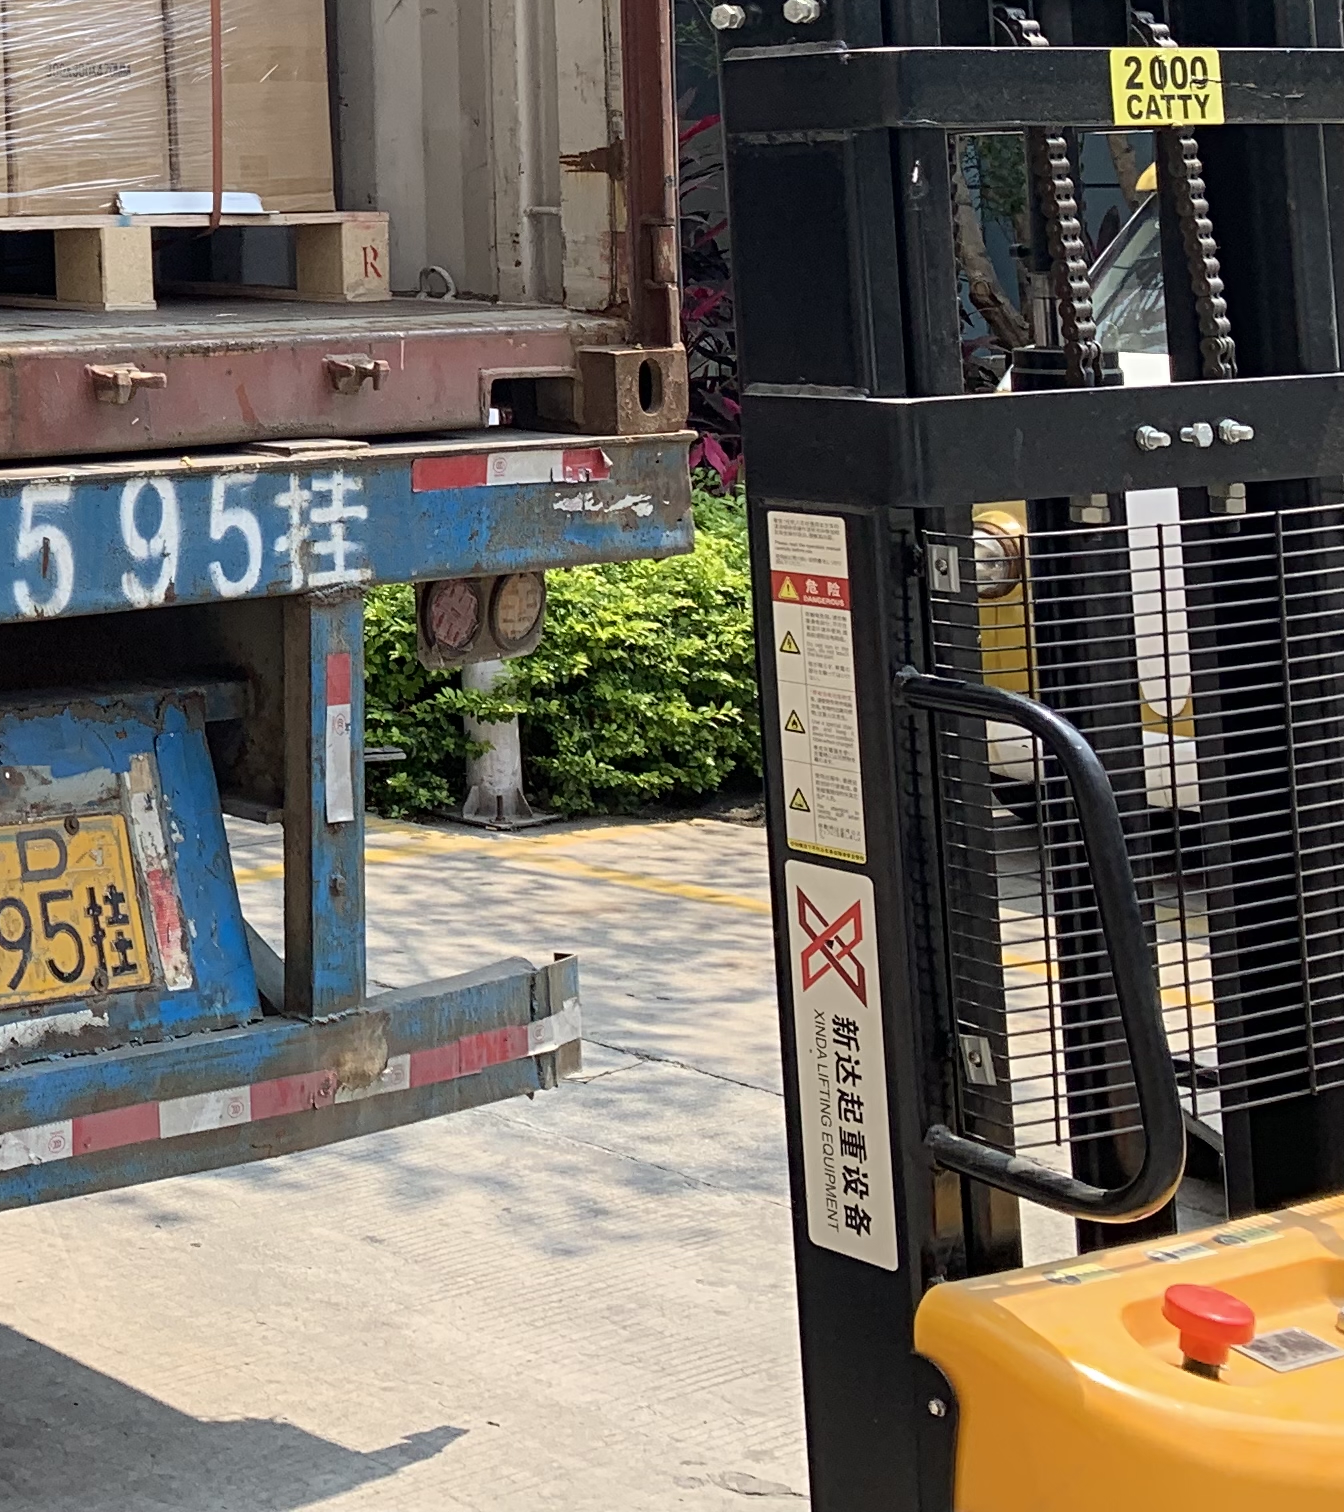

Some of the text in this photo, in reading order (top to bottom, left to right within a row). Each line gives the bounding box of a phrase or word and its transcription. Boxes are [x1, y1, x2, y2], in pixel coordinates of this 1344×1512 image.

[1123, 54, 1210, 91] 2000
[1126, 94, 1211, 121] CATTY
[361, 245, 382, 278] R
[803, 595, 845, 607] DANGEROUS
[805, 578, 840, 598] 危险
[813, 1008, 840, 1233] XINDA LIFTING EQUIPMENT
[831, 1013, 872, 1238] 新达起重设备
